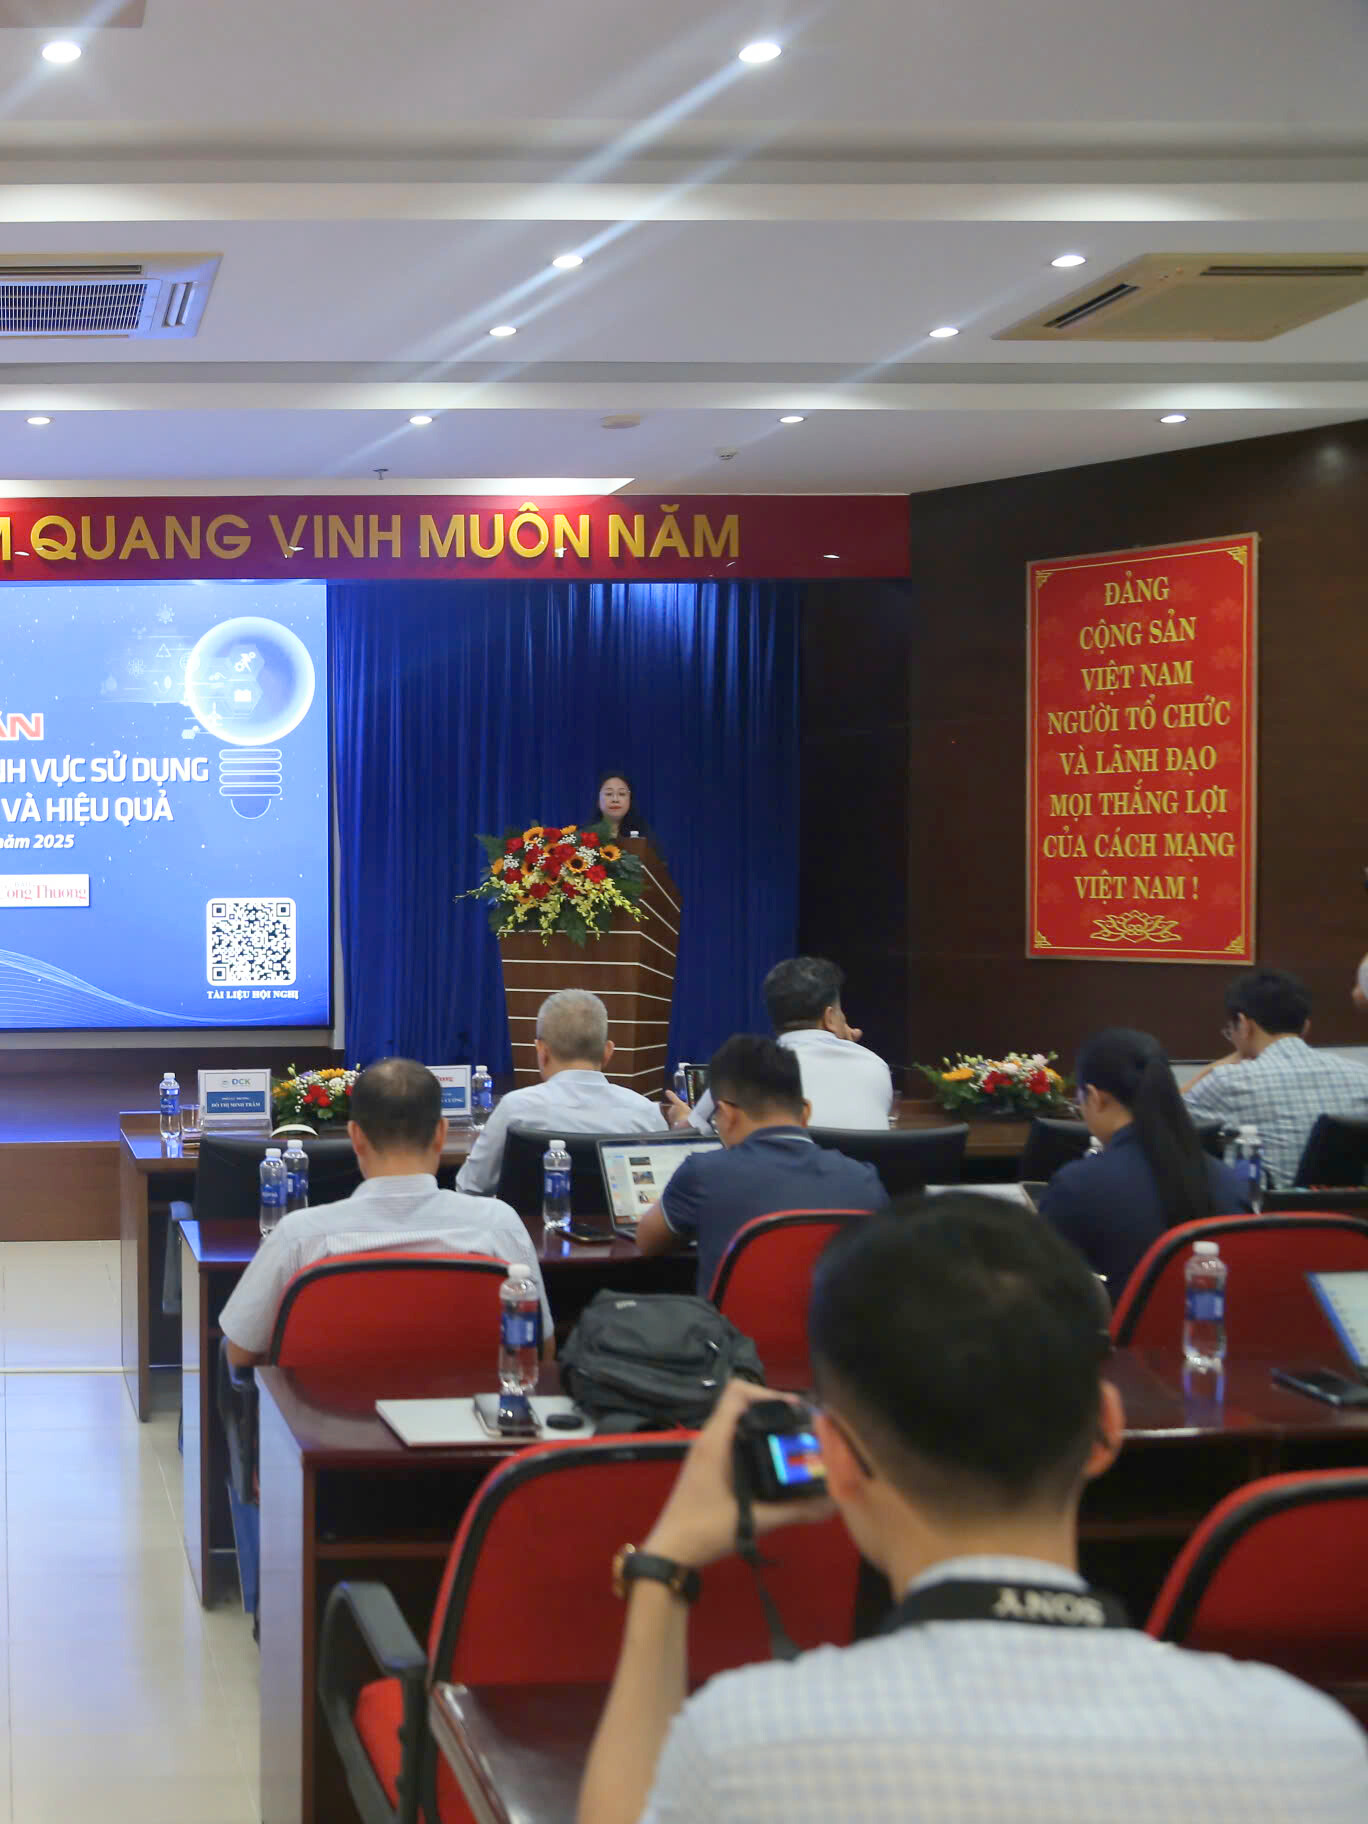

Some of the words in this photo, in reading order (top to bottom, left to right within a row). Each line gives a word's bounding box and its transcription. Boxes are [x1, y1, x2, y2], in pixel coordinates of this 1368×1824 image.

[29, 513, 251, 560] QUANG
[269, 513, 401, 559] VINH
[420, 502, 591, 559] MUÔN
[608, 505, 739, 559] NĂM
[1104, 571, 1169, 606] ĐẢNG
[1080, 619, 1141, 654] CỘNG
[1149, 609, 1197, 643] SẢN
[1081, 660, 1134, 695] VIỆT
[1141, 661, 1192, 687] NAM
[1048, 704, 1119, 735] NGƯỜI
[1125, 694, 1156, 730] TỔ
[1162, 695, 1231, 727] CHỨC
[31, 754, 86, 787] VỰC
[91, 750, 128, 783] SỬ
[133, 757, 209, 787] DỤNG
[1059, 746, 1088, 775] VÀ
[1096, 744, 1158, 773] LÃNH
[1166, 746, 1217, 776] ĐẠO
[1, 791, 41, 822] VÀ
[46, 792, 109, 826] HIỆU
[114, 789, 174, 826] QUẢ
[1049, 793, 1092, 822] MỌI
[1099, 779, 1178, 816] THẮNG
[1185, 785, 1227, 819] LỢI
[33, 833, 75, 849] 2025
[1043, 825, 1087, 858] CỦA
[1094, 828, 1156, 857] CÁCH
[1164, 832, 1235, 862] MẠNG
[1074, 870, 1126, 904] VIỆT
[1133, 876, 1185, 900] NAM
[207, 990, 224, 999] TÀI
[226, 990, 250, 1000] LIỆU
[252, 989, 271, 1000] HỘI
[273, 990, 299, 1000] NGHỊ
[992, 1586, 1105, 1625] SONY
